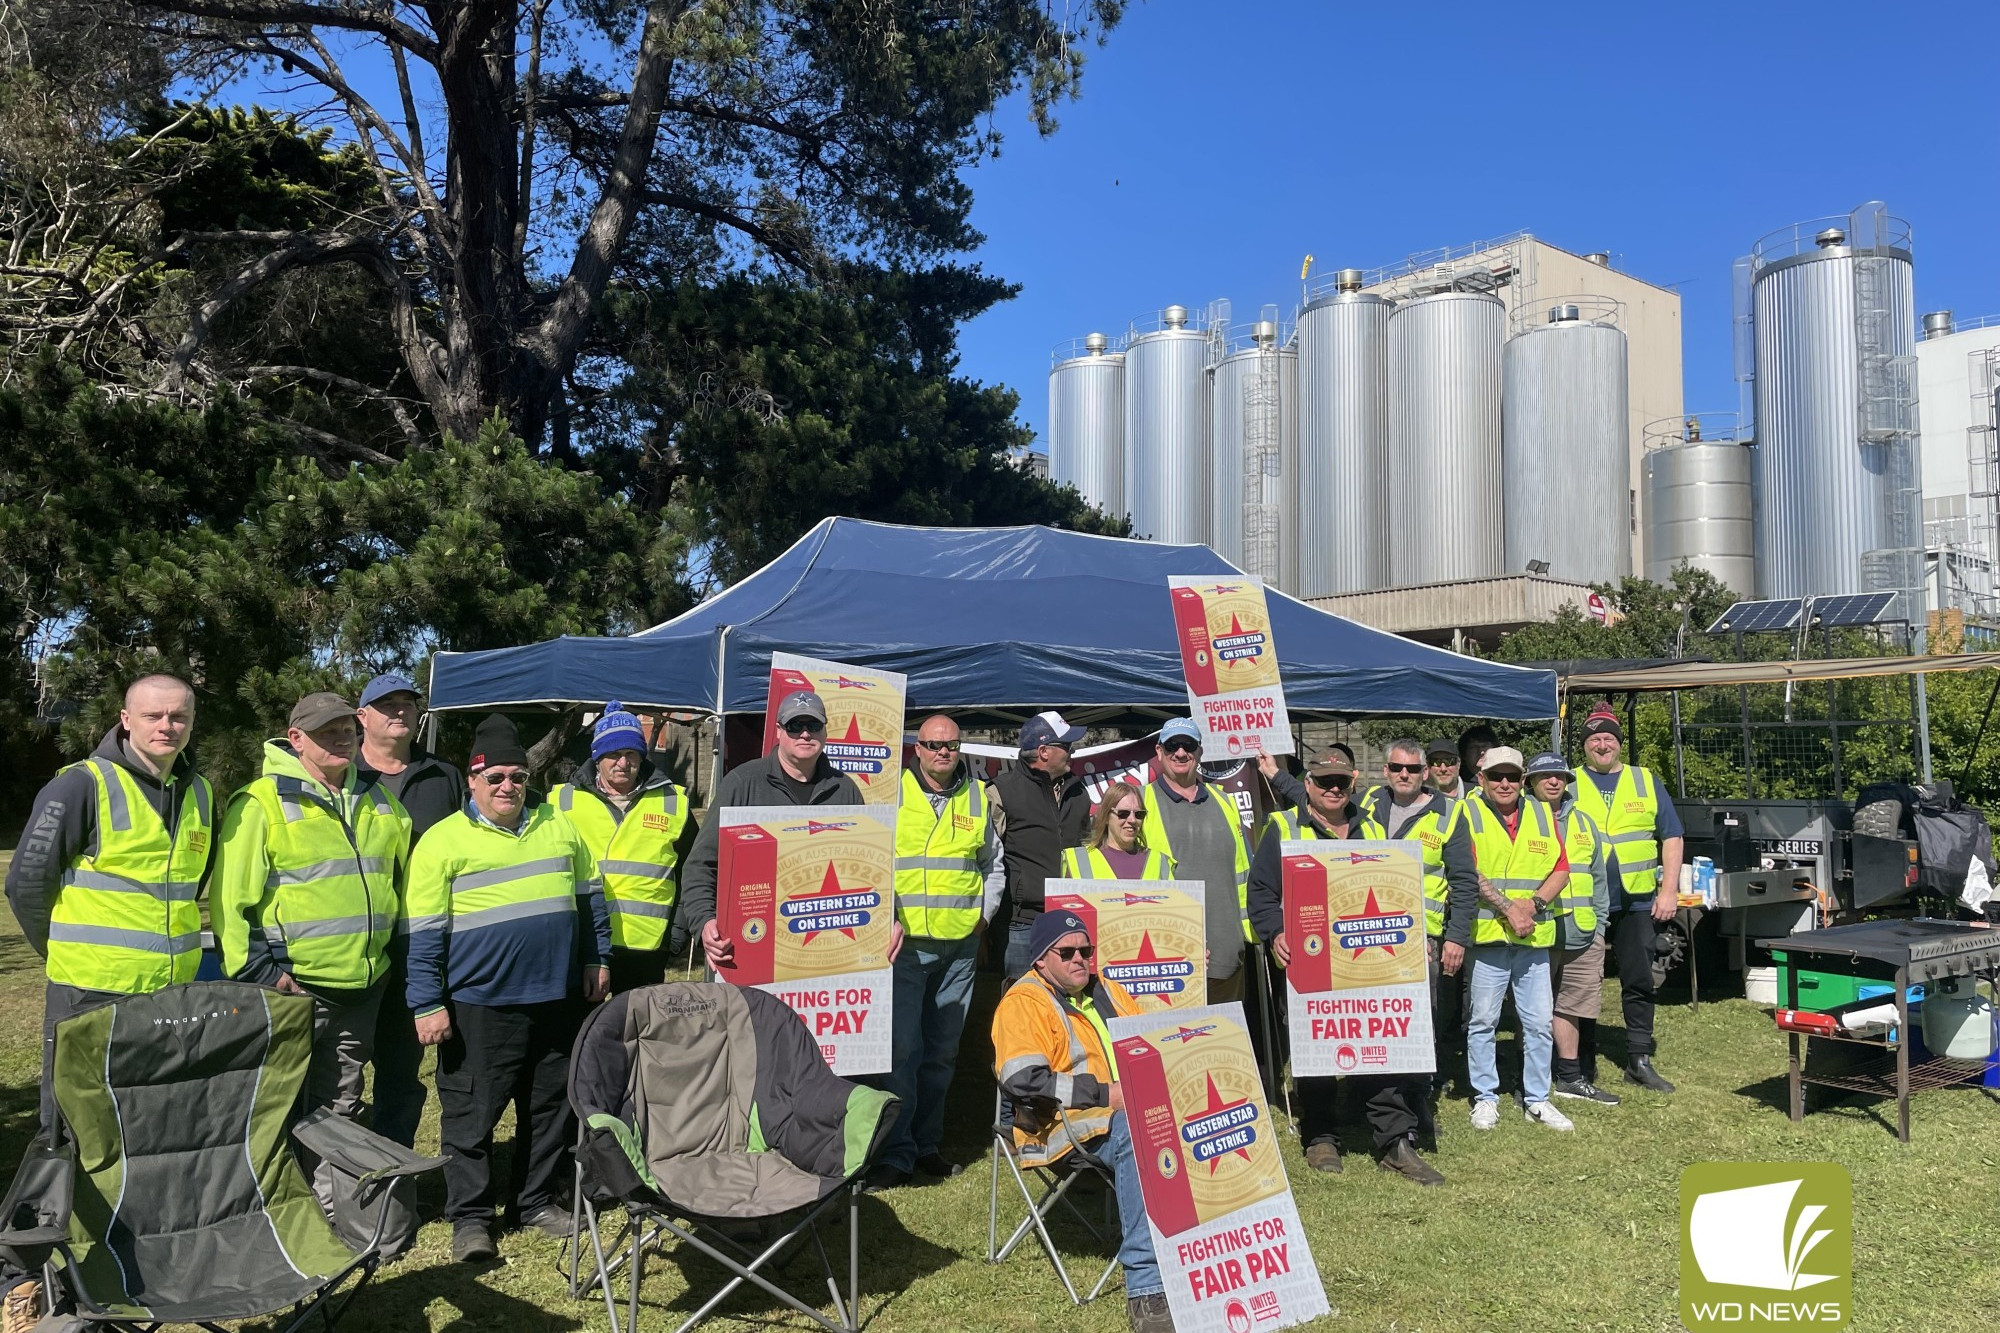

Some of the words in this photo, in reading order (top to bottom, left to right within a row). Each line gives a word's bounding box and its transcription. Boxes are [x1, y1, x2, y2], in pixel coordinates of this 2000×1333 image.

[1216, 637, 1246, 648] WESTERN
[1246, 634, 1263, 643] STAR
[1224, 650, 1234, 659] ON
[1234, 647, 1257, 658] STRIKE
[837, 701, 889, 717] AUSTRALIAN
[1203, 699, 1251, 713] FIGHTING
[1253, 697, 1275, 709] FOR
[860, 716, 894, 739] 1926
[1208, 715, 1243, 732] FAIR
[1245, 712, 1274, 729] PAY
[1243, 735, 1260, 744] UNITED
[864, 746, 887, 757] STAR
[841, 761, 874, 772] STRIKE
[643, 813, 669, 825] UNITED
[1420, 831, 1441, 845] UNITED
[1528, 839, 1548, 849] UNITED
[805, 846, 875, 860] AUSTRALIAN
[1777, 841, 1819, 854] SERIES
[839, 861, 884, 884] 1926
[740, 882, 770, 892] ORIGINAL
[1350, 875, 1407, 887] AUSTRALIAN
[787, 897, 844, 914] WESTERN
[846, 893, 875, 908] STAR
[1377, 888, 1414, 909] 1926
[798, 918, 816, 931] ON
[818, 914, 860, 928] STRIKE
[1122, 917, 1186, 930] AUSTRALIAN
[1338, 918, 1383, 933] WESTERN
[1384, 917, 1409, 928] STAR
[1154, 932, 1196, 954] 1926
[1347, 936, 1362, 947] ON
[1363, 933, 1398, 945] STRIKE
[1108, 965, 1159, 979] WESTERN
[1161, 963, 1189, 975] STAR
[1137, 981, 1175, 992] STRIKE
[774, 990, 829, 1008] HTING
[835, 988, 872, 1006] FOR
[668, 1003, 712, 1014] IRONMAN
[1307, 999, 1378, 1015] FIGHTING
[1382, 998, 1413, 1013] FOR
[153, 1010, 227, 1025] Wanderer
[816, 1009, 868, 1036] PAY
[1312, 1018, 1362, 1040] FAIR
[1368, 1017, 1411, 1038] PAY
[820, 1044, 836, 1056] TED
[1361, 1045, 1387, 1056] UNITED
[1185, 1052, 1240, 1073] AUSTRALIAN
[1214, 1070, 1253, 1094] 1926
[1144, 1104, 1169, 1118] ORIGINAL
[1186, 1117, 1230, 1139] WESTERN
[1231, 1106, 1254, 1124] STAR
[1200, 1142, 1216, 1157] ON
[1215, 1130, 1249, 1152] STRIKE
[1177, 1227, 1253, 1266] FIGHTING
[1253, 1217, 1286, 1244] FOR
[1188, 1259, 1247, 1302] FAIR
[1245, 1243, 1291, 1283] PAY
[1249, 1290, 1277, 1311] UNITED
